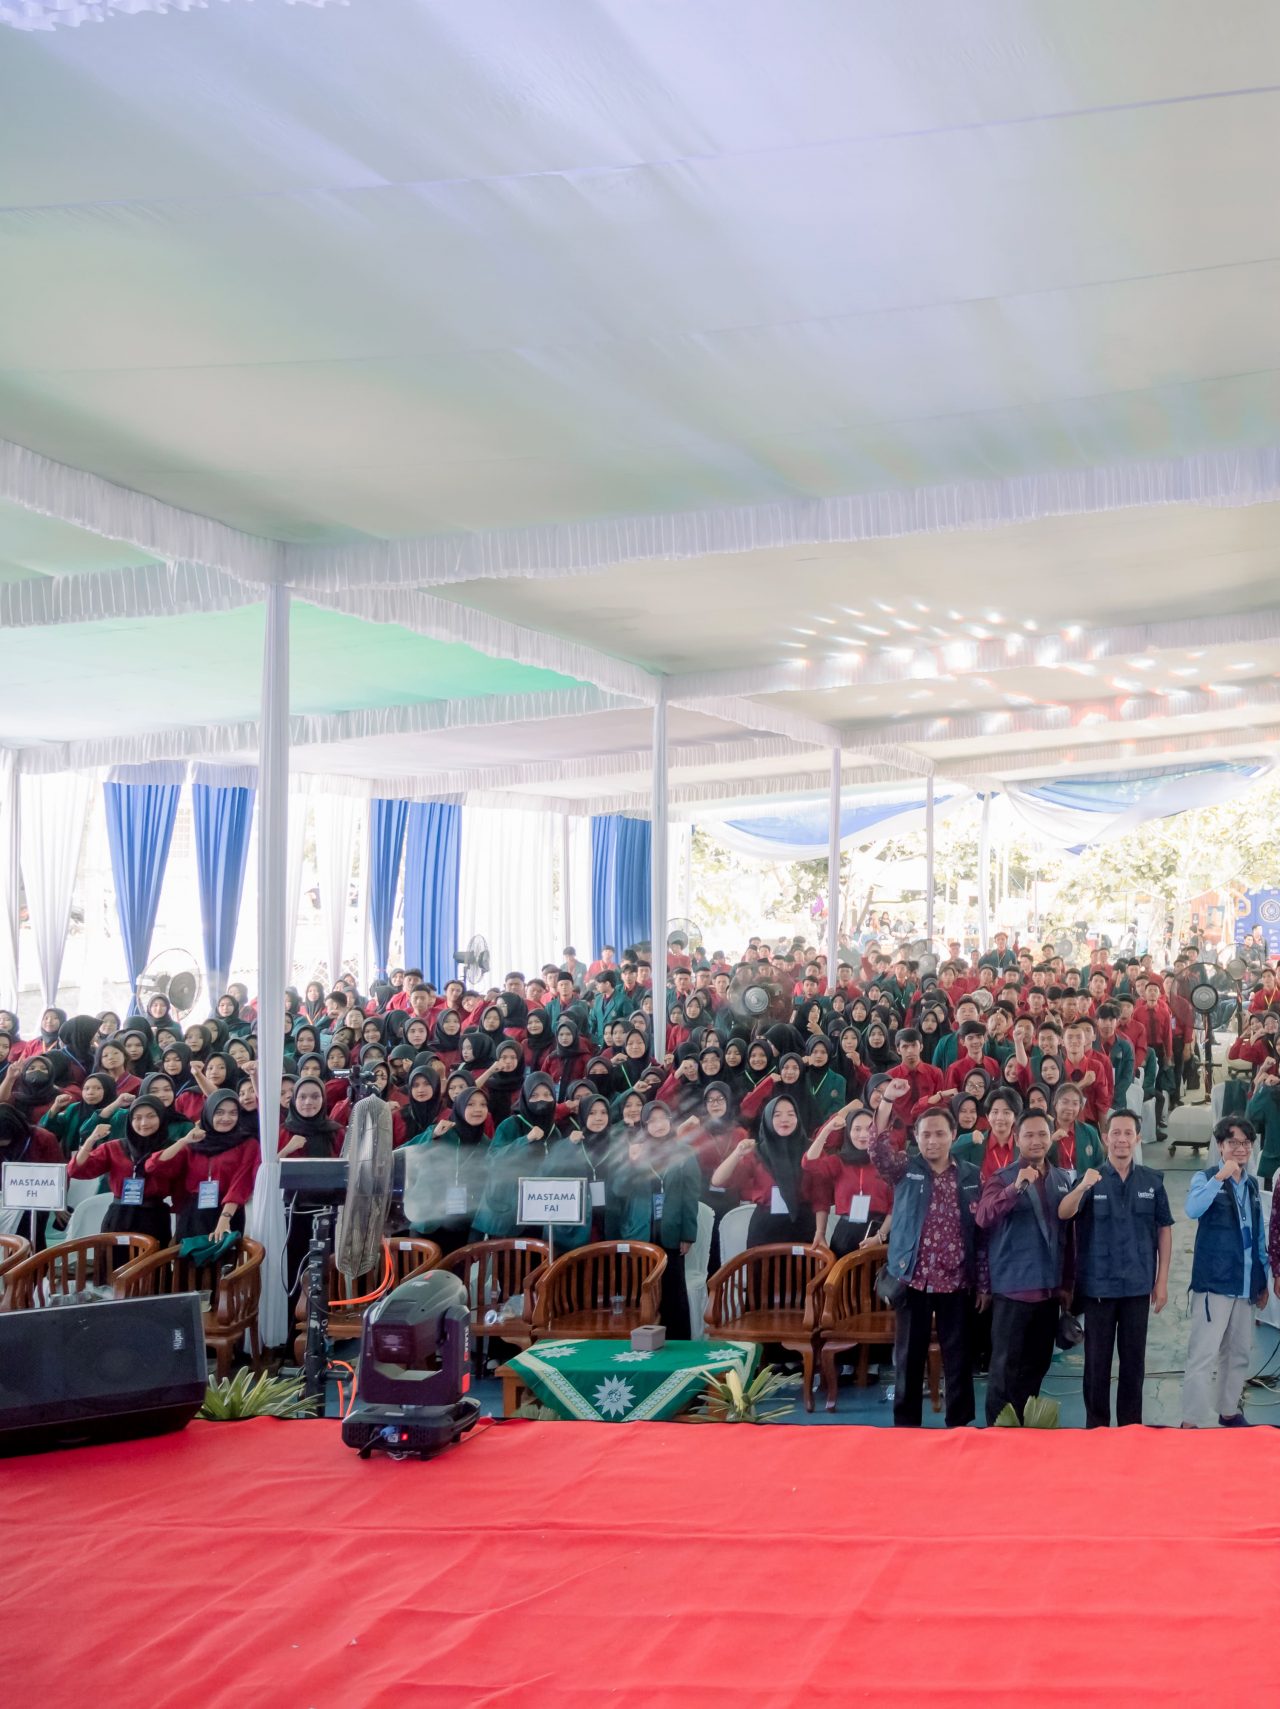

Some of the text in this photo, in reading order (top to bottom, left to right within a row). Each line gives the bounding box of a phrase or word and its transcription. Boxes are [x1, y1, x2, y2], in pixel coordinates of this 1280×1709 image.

[10, 1178, 56, 1187] MASTAMA
[26, 1190, 38, 1198] FH
[527, 1193, 576, 1201] MASTAMA
[544, 1204, 559, 1212] FAI
